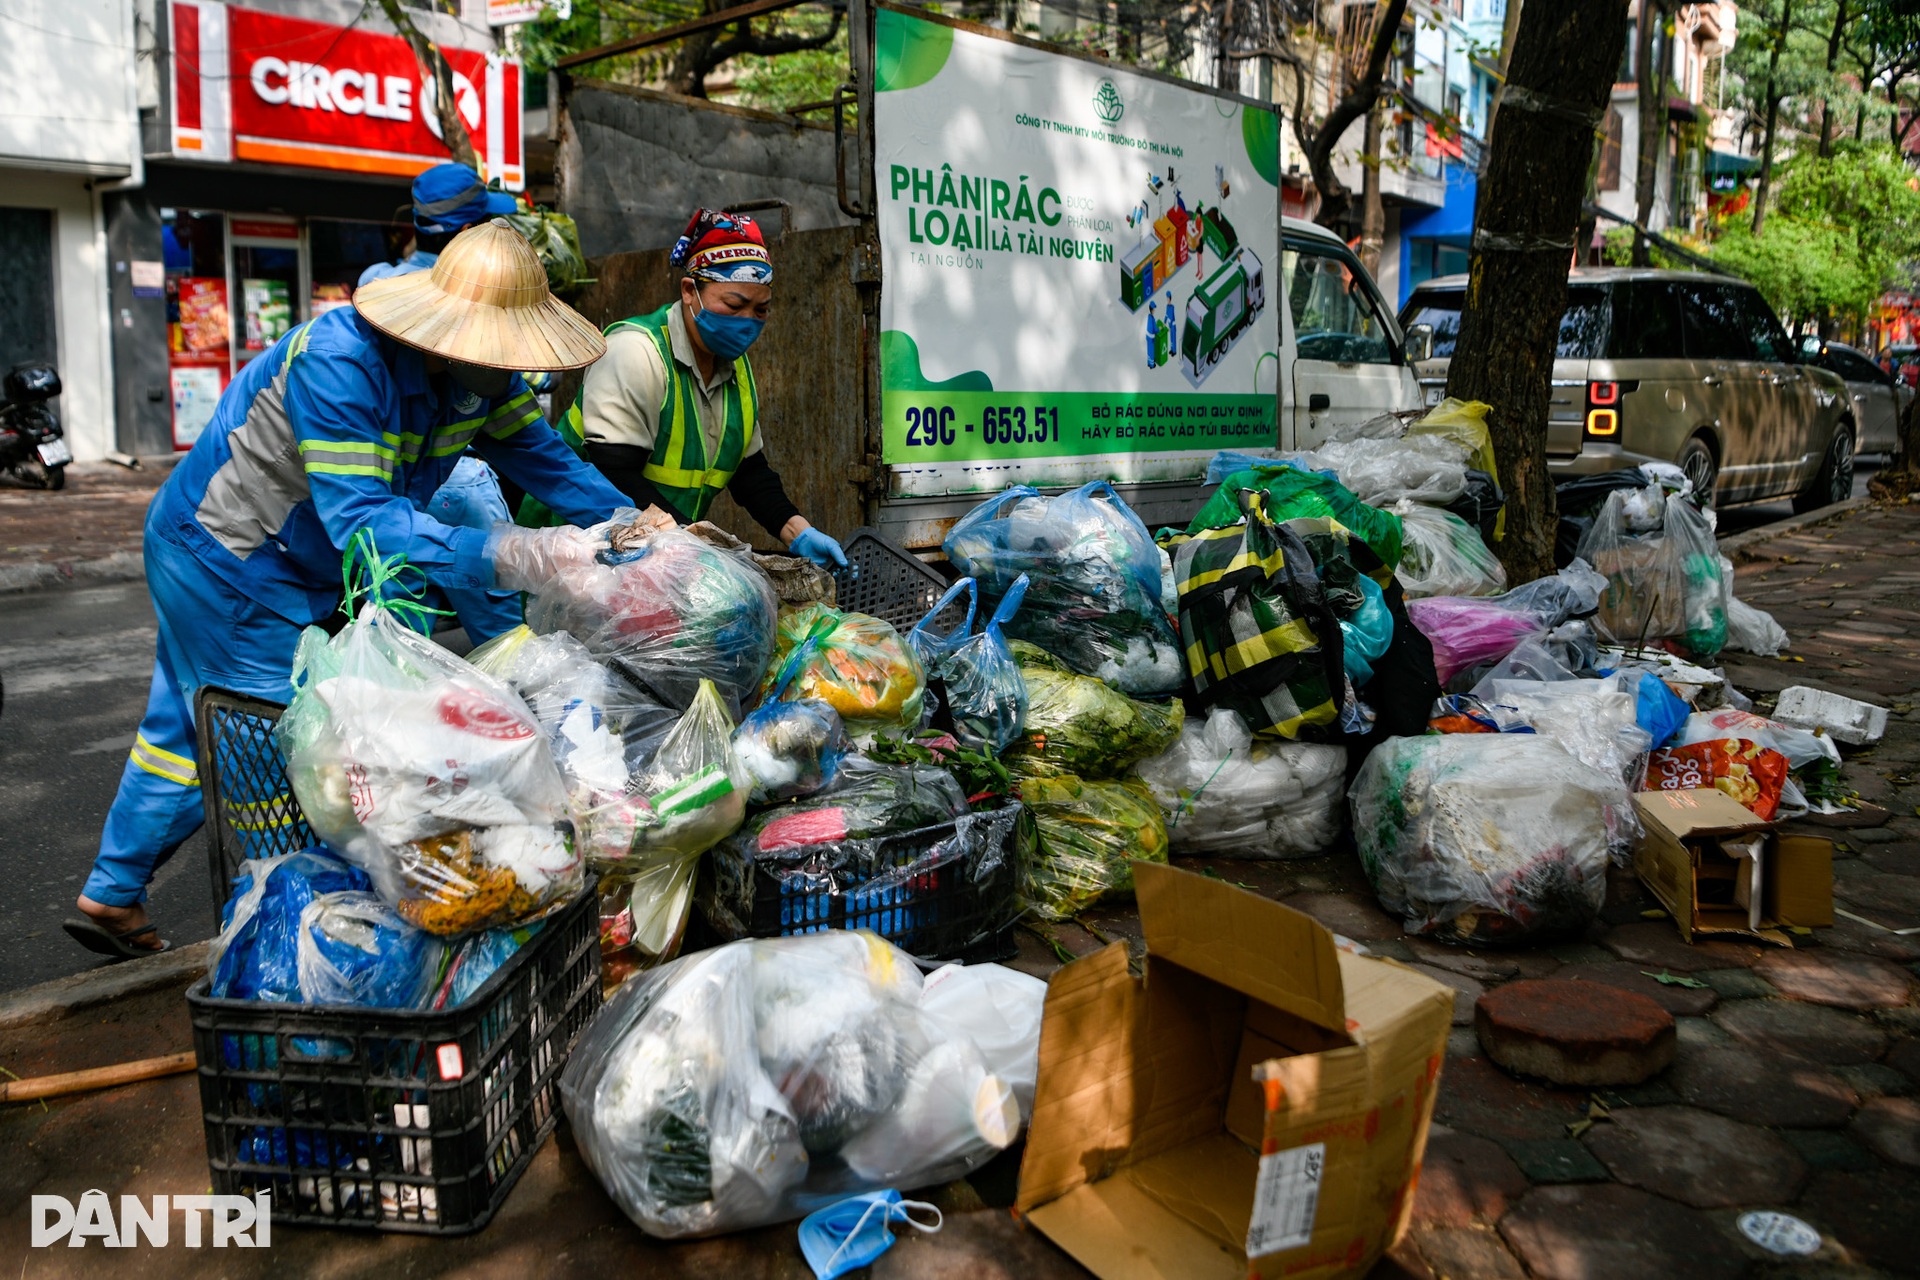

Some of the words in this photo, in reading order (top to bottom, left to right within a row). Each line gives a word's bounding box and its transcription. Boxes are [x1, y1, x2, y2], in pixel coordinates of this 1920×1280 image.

[250, 56, 412, 122] CIRCLE
[1015, 113, 1041, 128] CÔNG
[1042, 119, 1051, 130] TY
[1053, 121, 1073, 135] TNHH
[1075, 126, 1090, 138] MTV
[1091, 129, 1106, 142] MÔI
[1107, 133, 1135, 148] TRƯỜNG
[1137, 138, 1148, 151] ĐÔ
[1149, 142, 1160, 155] THỊ
[1160, 143, 1170, 156] HÀ
[1171, 145, 1184, 159] NỘI
[890, 162, 982, 212] PHÂN
[990, 174, 1063, 227] RÁC
[908, 206, 983, 252] LOẠI
[991, 224, 1013, 253] LÀ
[1017, 228, 1044, 256] TÀI
[1049, 237, 1114, 263] NGUYÊN
[1066, 214, 1092, 232] PHÂN
[1092, 219, 1114, 235] LOẠI
[910, 251, 931, 268] TẠI
[905, 405, 956, 447] 29C
[982, 405, 1060, 445] 653.51
[1082, 423, 1112, 439] HÃY
[1115, 422, 1135, 438] BỎ
[1138, 421, 1165, 438] RÁC
[1169, 421, 1195, 437] VÀO
[1199, 421, 1217, 436] TÚI
[1220, 421, 1250, 438] BUỘC
[1252, 421, 1271, 435] KÍN
[1091, 401, 1111, 418] BỎ
[1115, 401, 1143, 418] RÁC
[1147, 402, 1183, 418] ĐÚNG
[1187, 405, 1207, 418] NƠI
[1211, 405, 1235, 418] QUY
[1238, 405, 1263, 419] ĐỊNH
